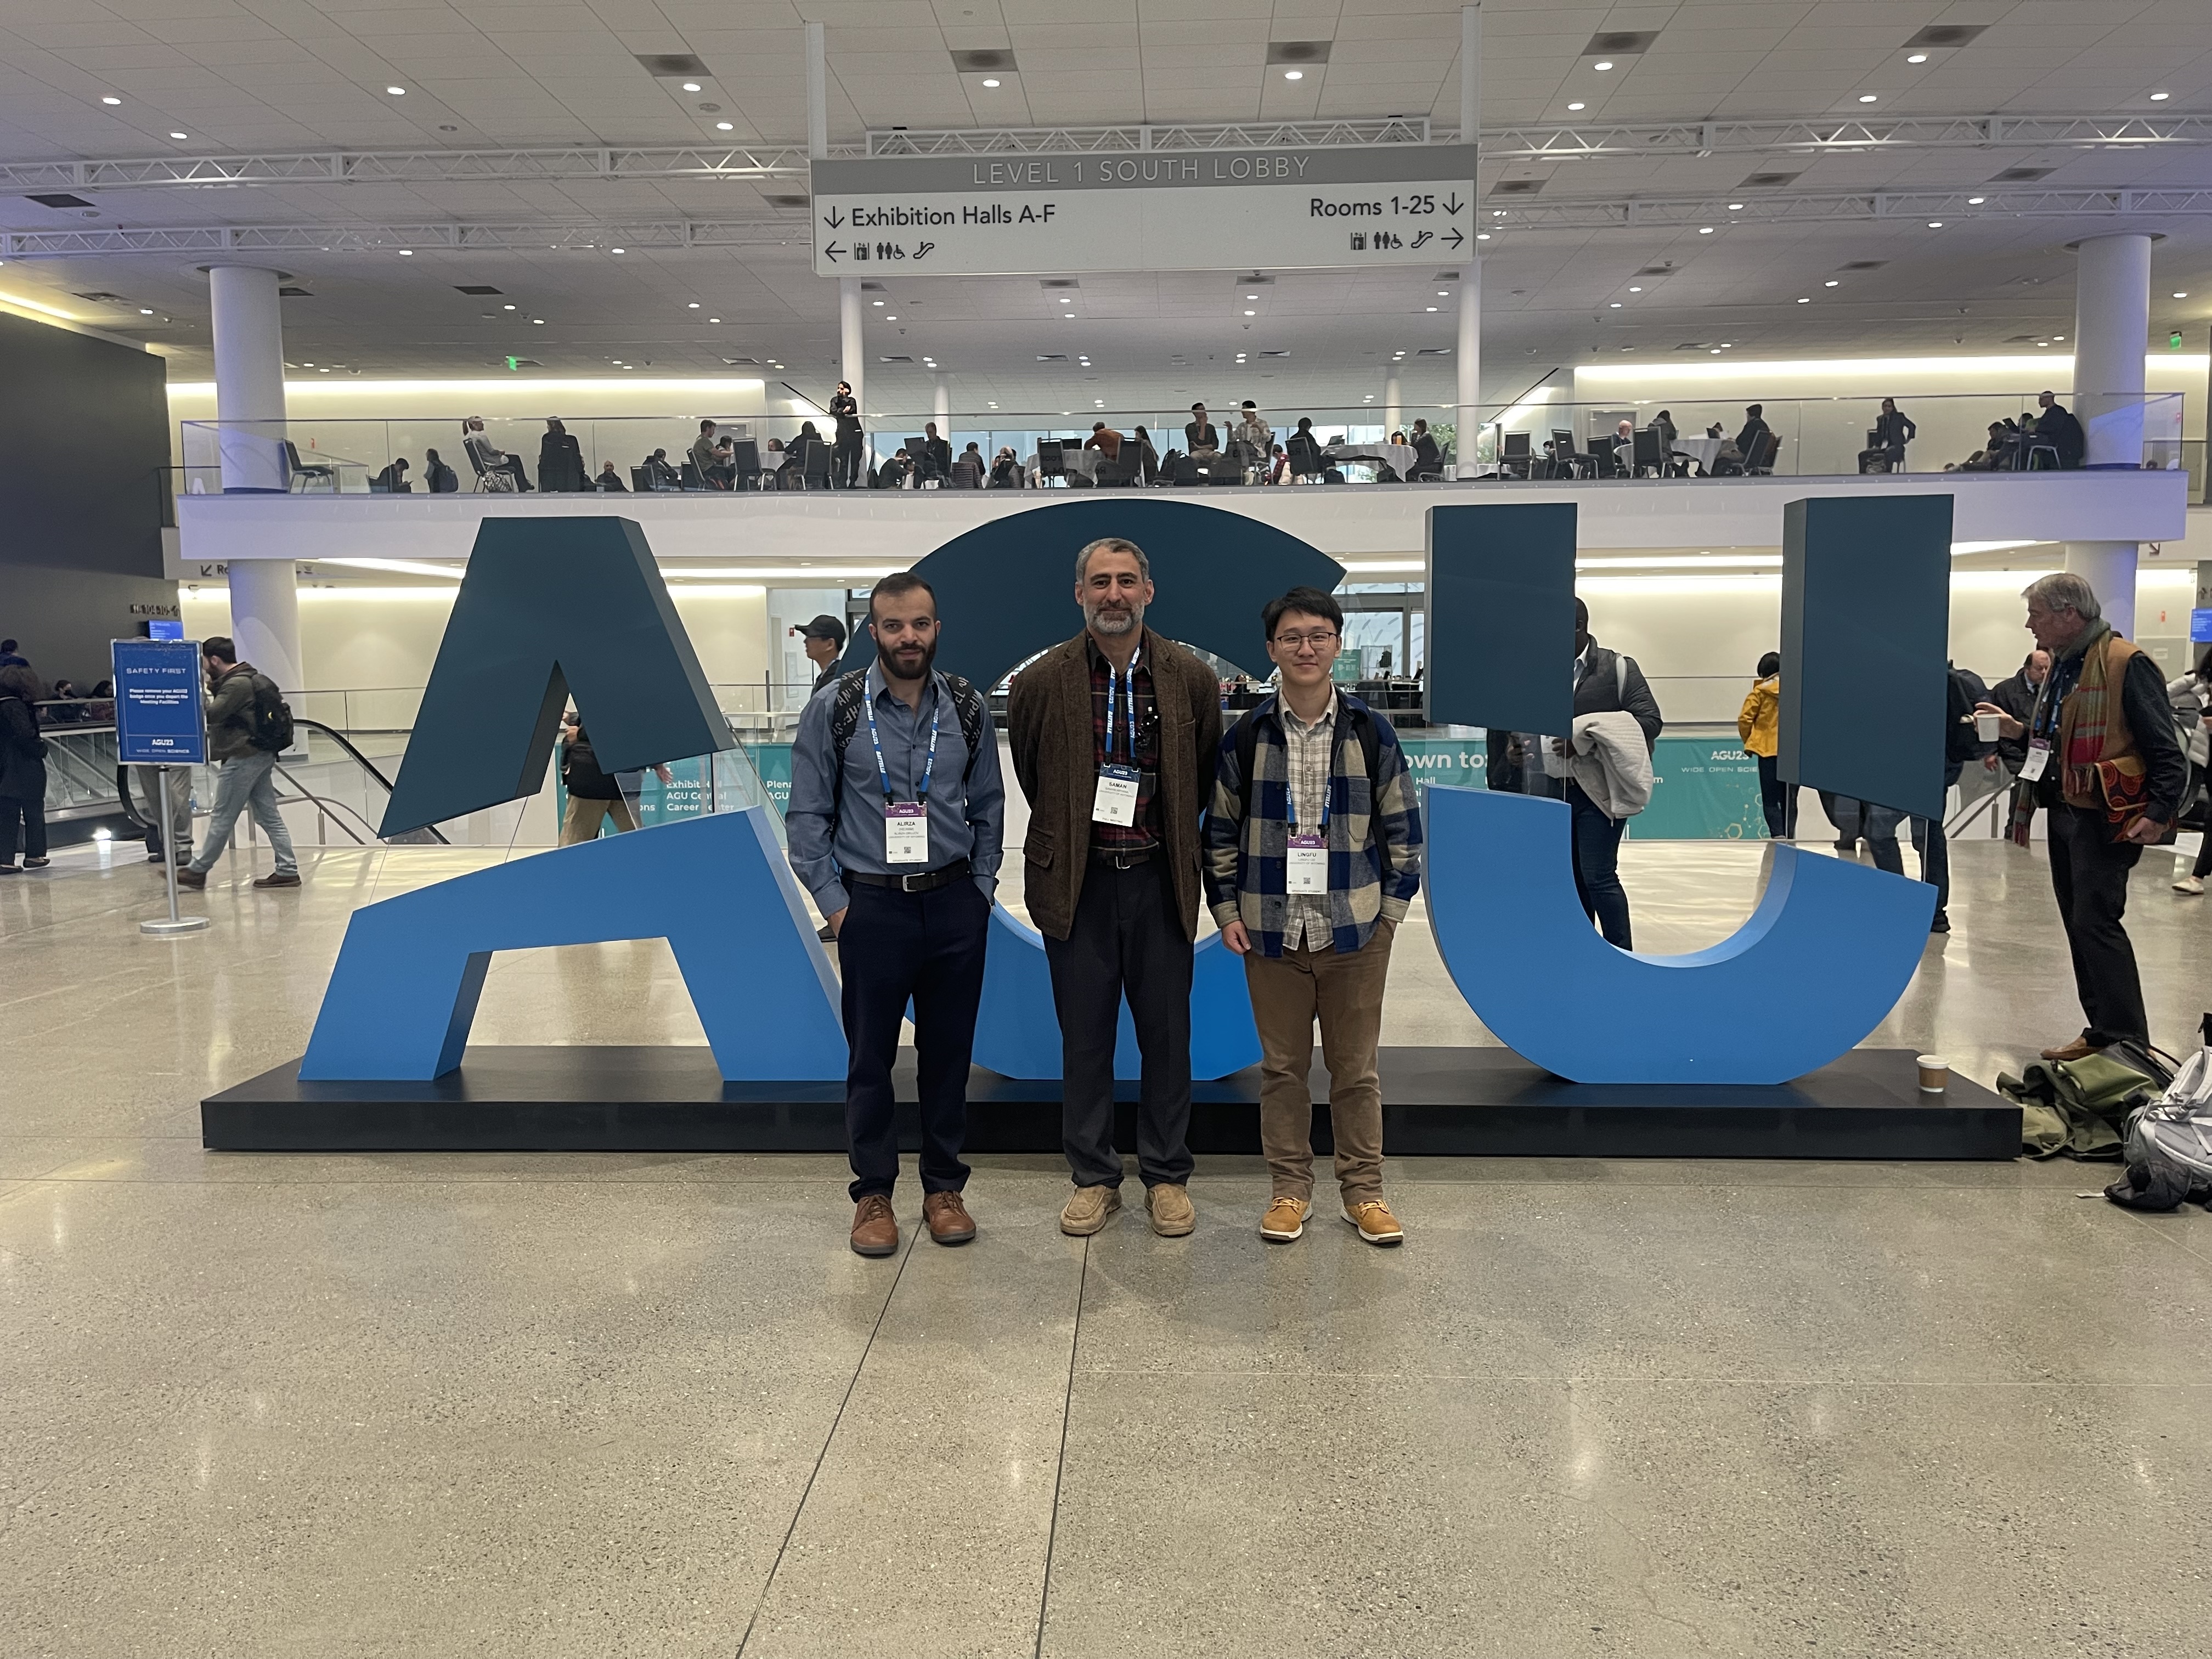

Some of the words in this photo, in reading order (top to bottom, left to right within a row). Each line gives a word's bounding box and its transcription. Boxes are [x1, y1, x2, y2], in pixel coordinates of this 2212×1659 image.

[973, 162, 1059, 184] LEVEL
[1074, 161, 1082, 182] 1
[1099, 159, 1198, 182] SOUTH
[1214, 156, 1310, 179] LOBBY
[852, 206, 955, 227] Exhibition
[963, 204, 1012, 224] Halls
[1018, 204, 1056, 223] A-F
[1311, 198, 1383, 217] Rooms
[1390, 195, 1435, 215] 1-25
[1416, 776, 1436, 785] Hall
[667, 792, 688, 800] AGU
